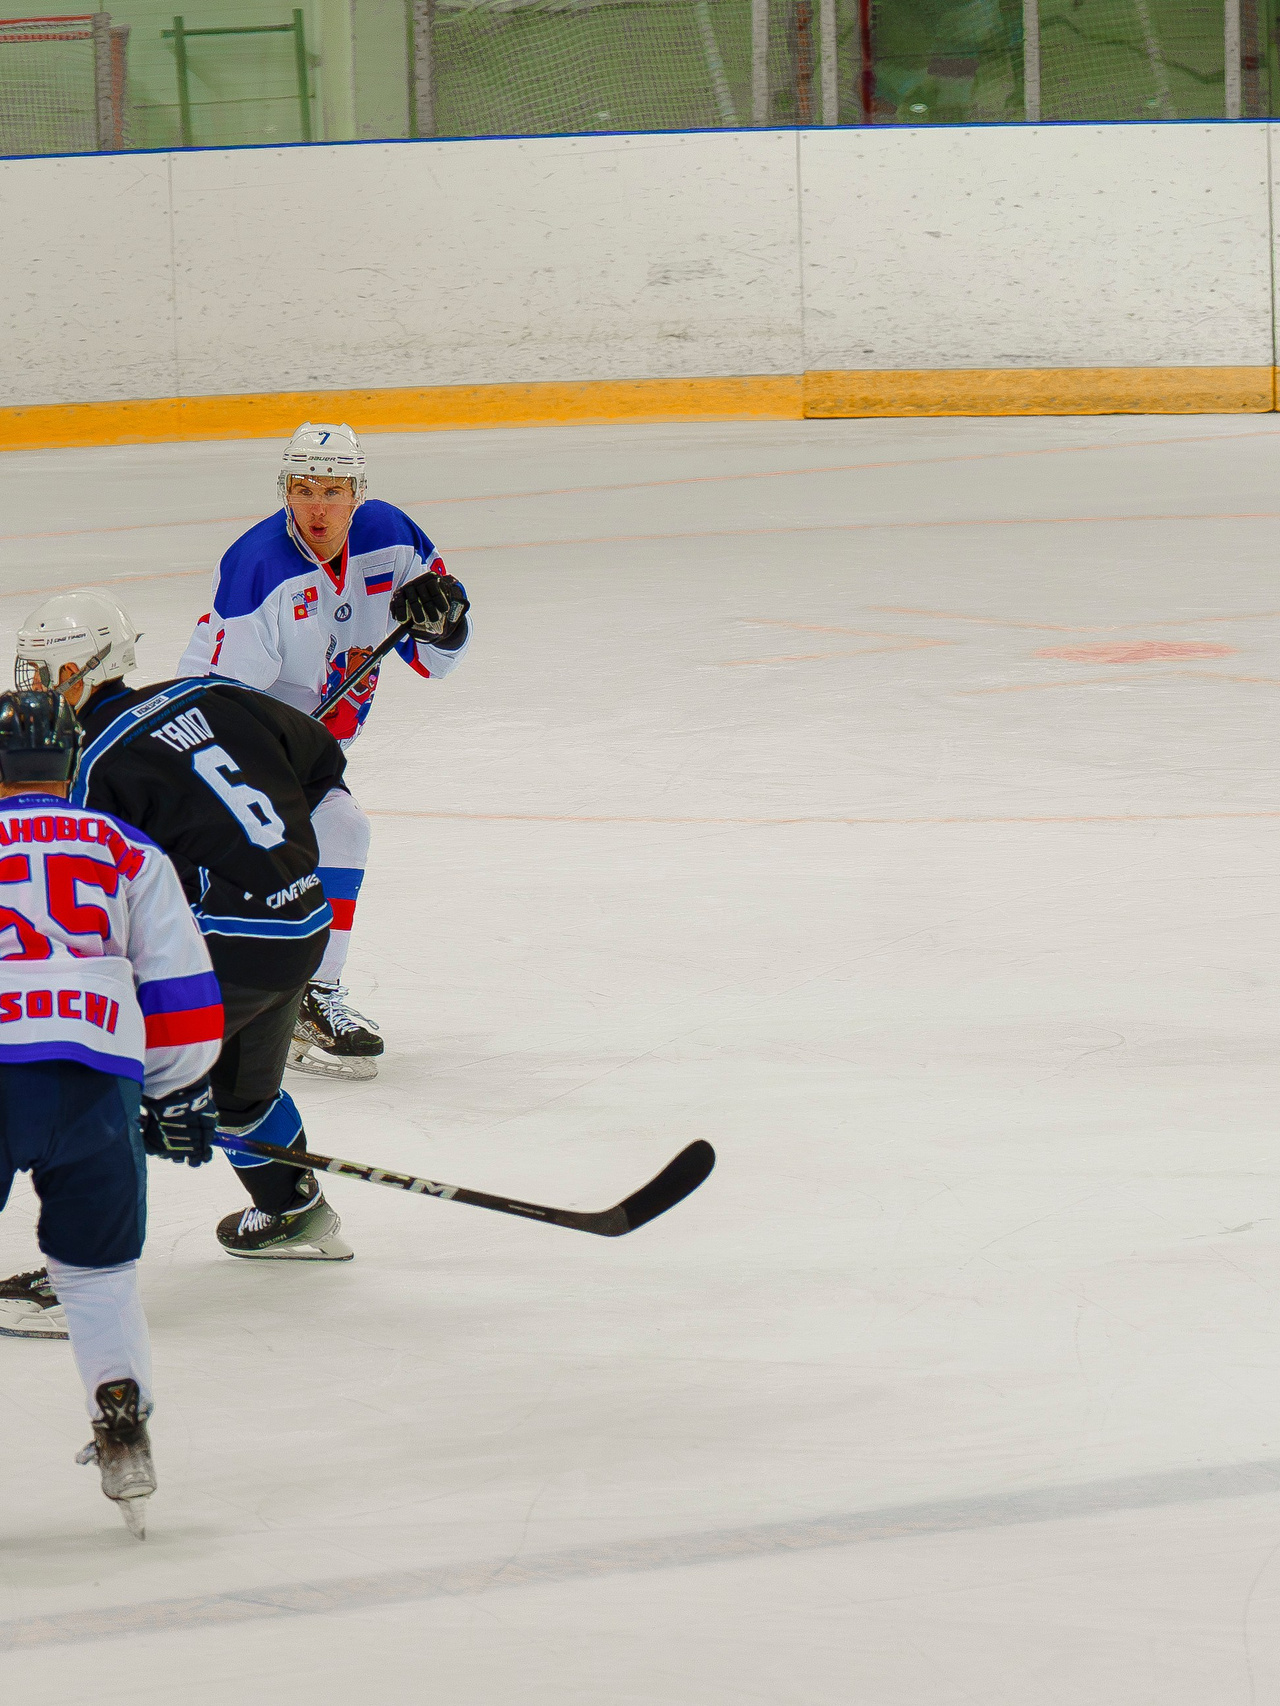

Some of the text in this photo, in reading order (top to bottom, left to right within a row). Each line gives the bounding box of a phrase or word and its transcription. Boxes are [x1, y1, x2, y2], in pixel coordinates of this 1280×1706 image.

[318, 431, 331, 446] 7
[191, 743, 288, 851] 6
[162, 1085, 213, 1118] CC
[326, 1157, 460, 1200] CCM
